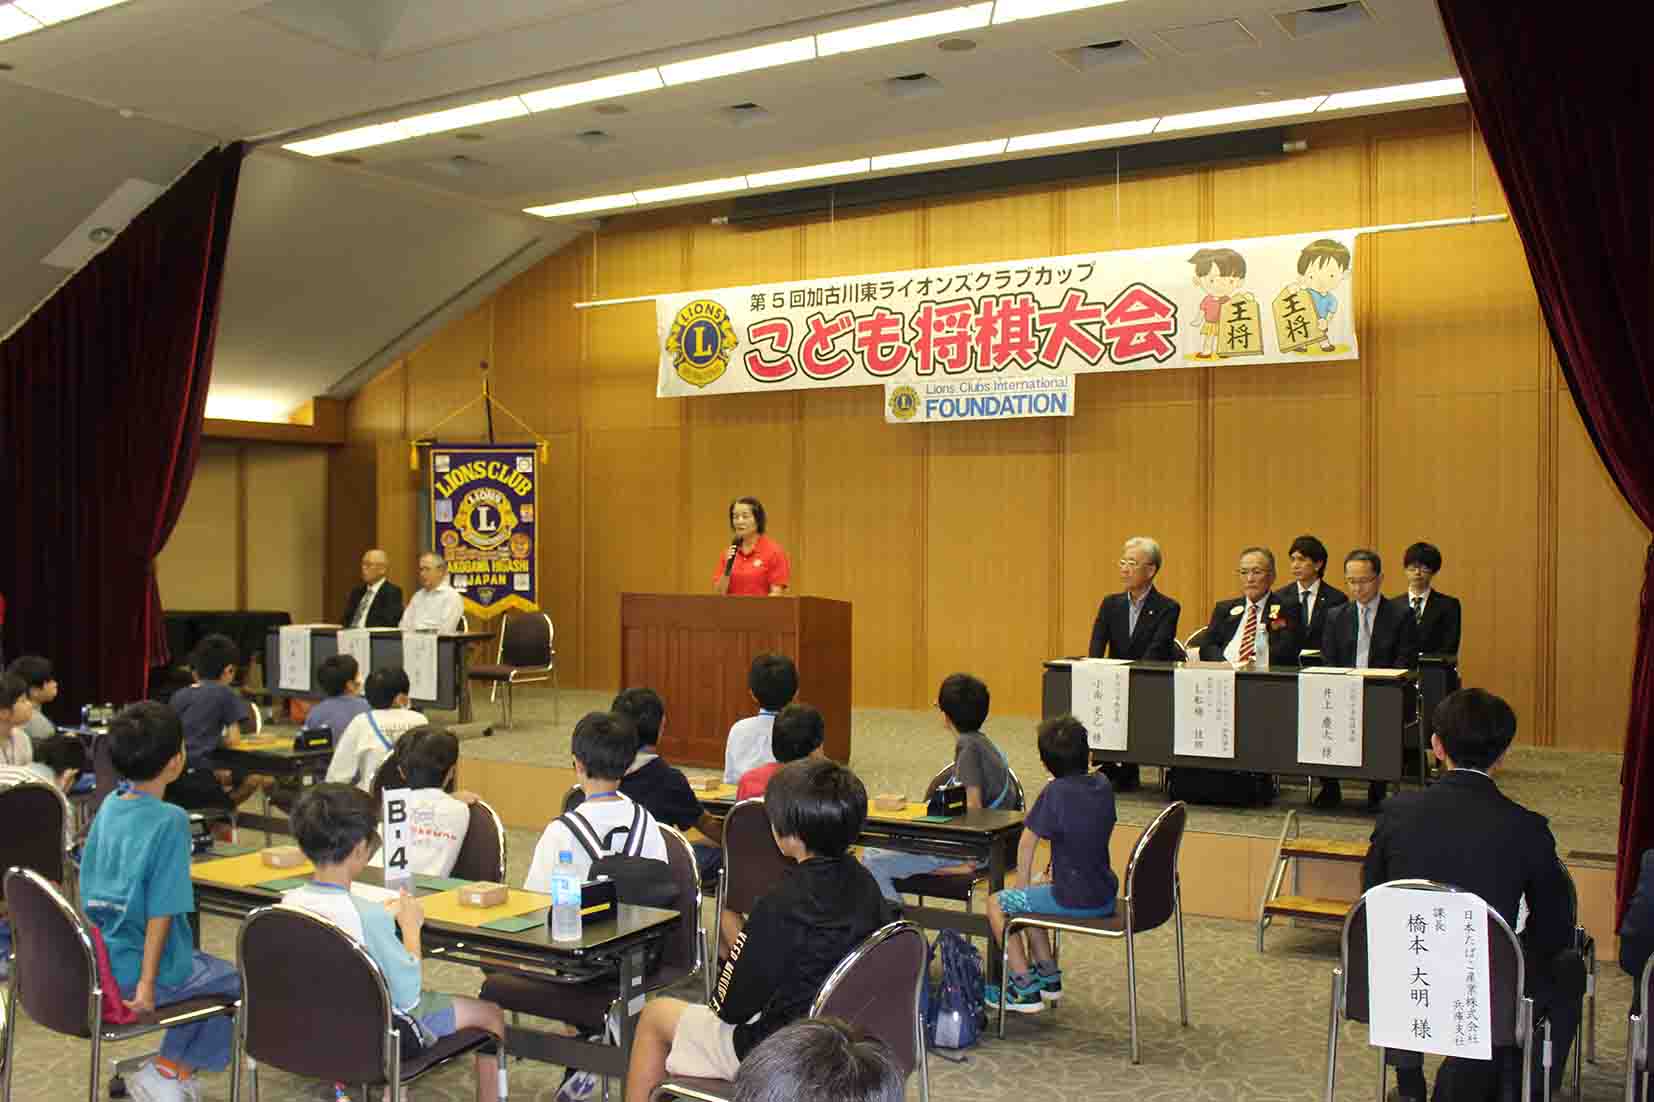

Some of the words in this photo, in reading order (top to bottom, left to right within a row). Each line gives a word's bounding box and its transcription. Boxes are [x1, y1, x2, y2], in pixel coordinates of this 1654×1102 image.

[750, 260, 1097, 312] 第5回加古川東ライオンズクラブカップ
[681, 303, 722, 322] LIONS
[1227, 300, 1253, 350] 王将
[1282, 293, 1311, 343] 王将
[693, 326, 713, 357] L
[744, 282, 1178, 383] こども将棋大会
[926, 383, 955, 395] Lions
[959, 381, 990, 393] Clubs
[993, 376, 1068, 391] International
[926, 392, 1068, 418] FOUNDATION
[436, 462, 487, 497] LIONS
[477, 506, 497, 532] L
[467, 574, 507, 585] JAPAN
[1408, 914, 1430, 956] 橋本
[1410, 967, 1431, 1009] 大明
[1411, 1016, 1433, 1040] 様
